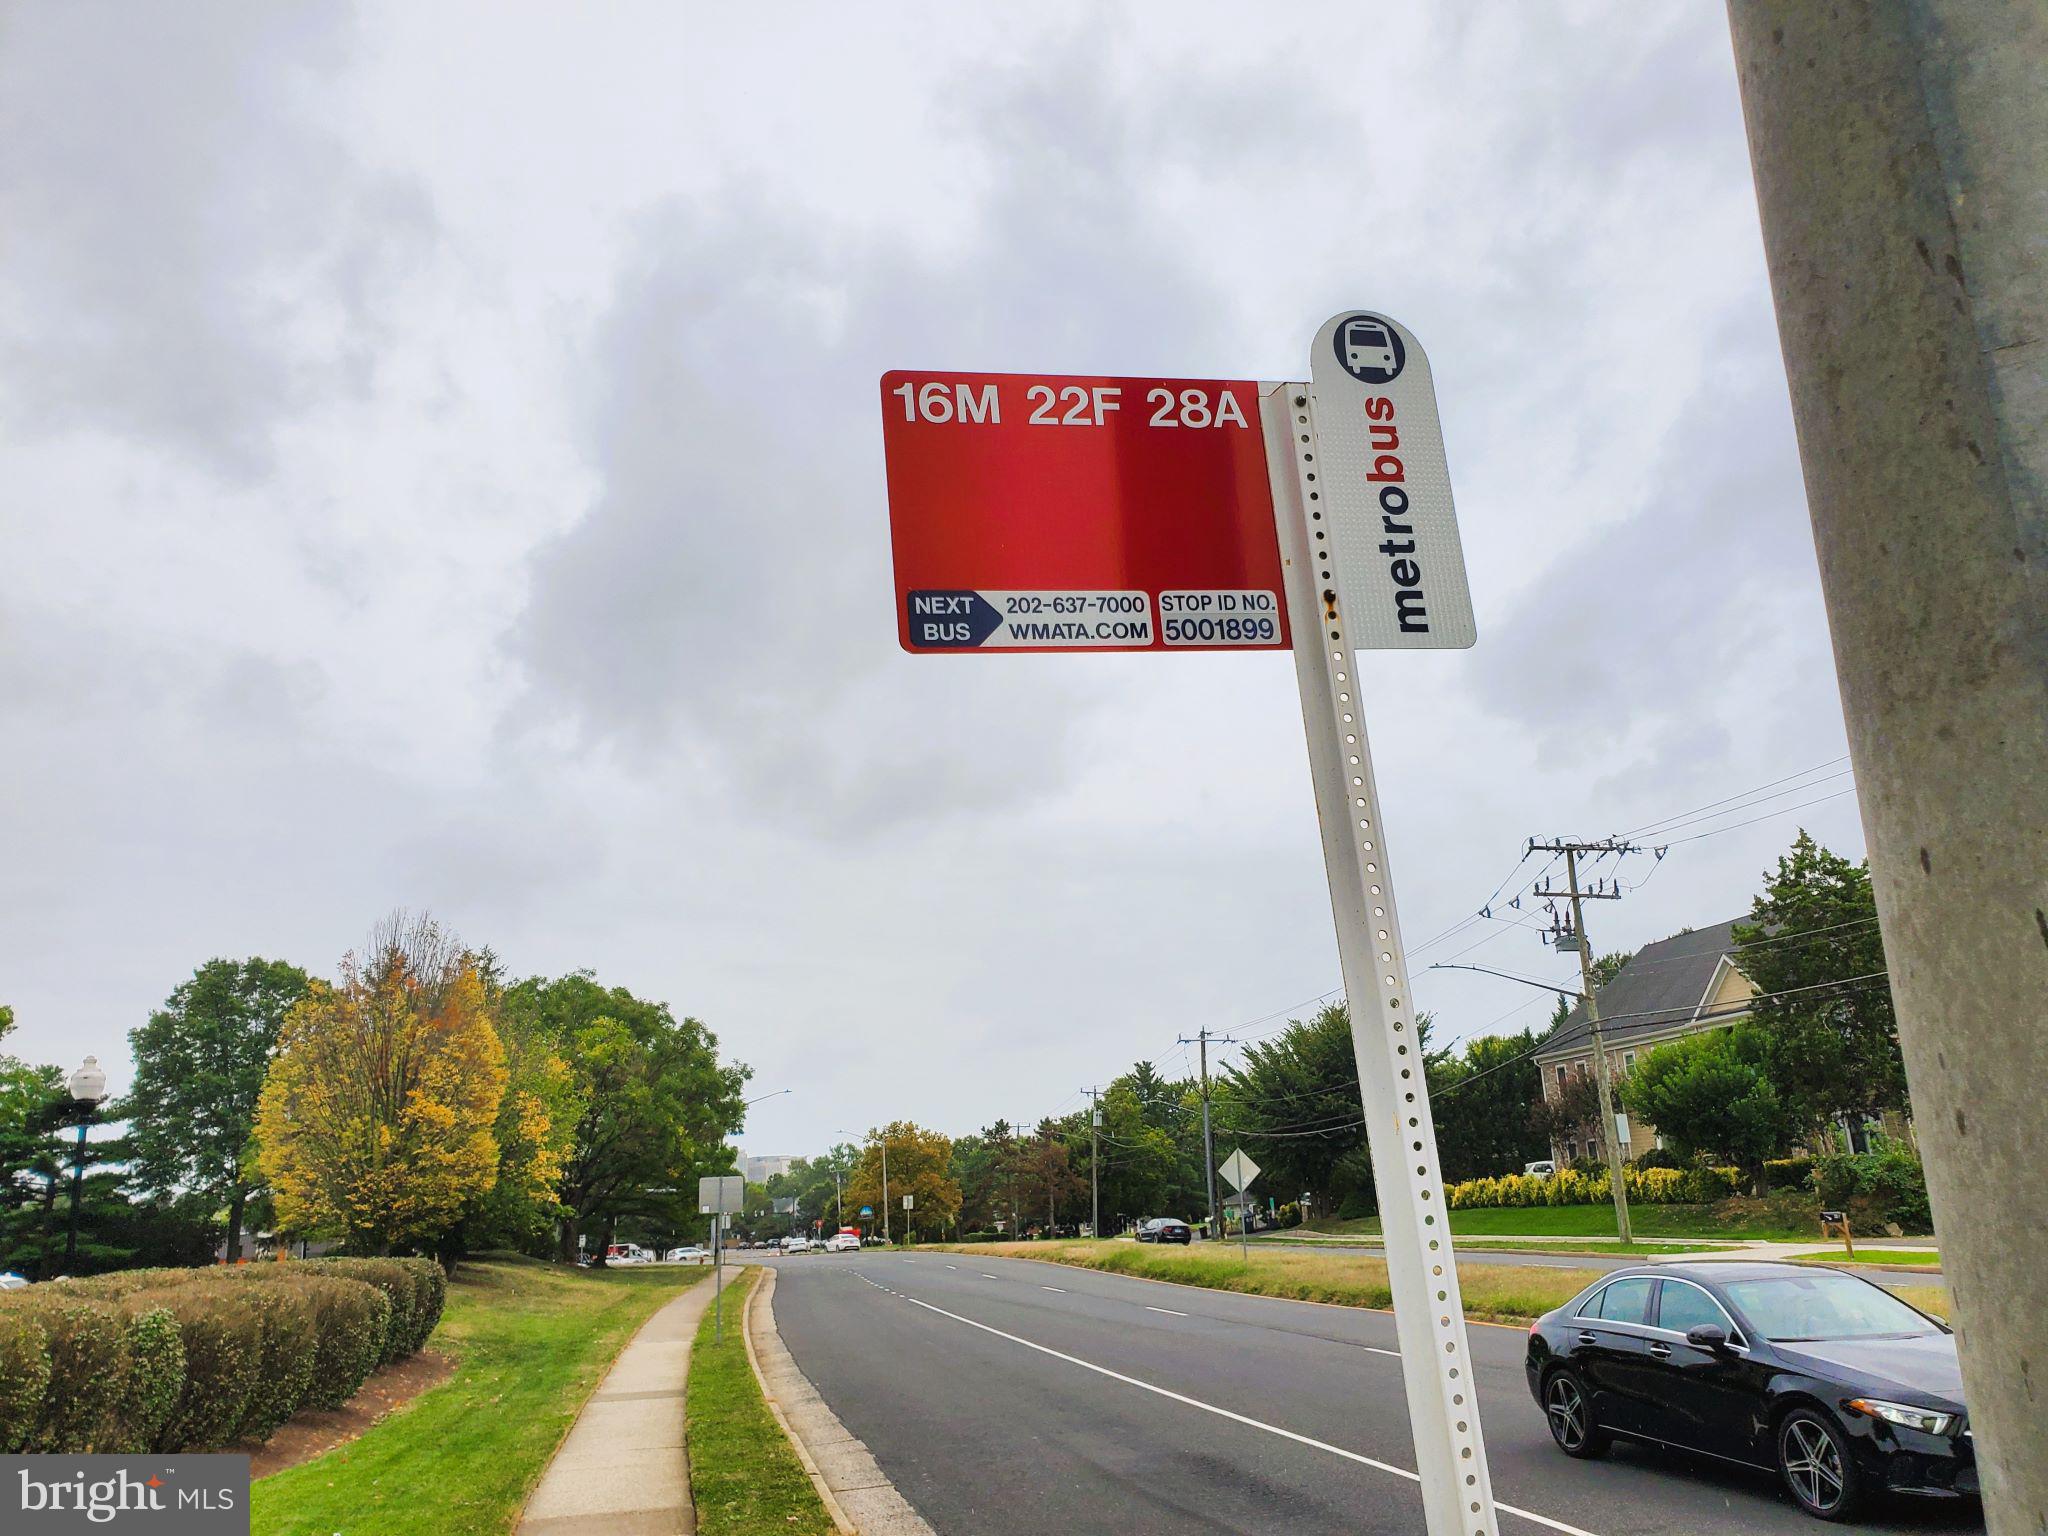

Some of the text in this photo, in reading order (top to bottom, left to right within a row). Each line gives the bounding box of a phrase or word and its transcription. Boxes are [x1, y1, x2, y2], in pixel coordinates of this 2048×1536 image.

[893, 382, 1249, 429] 16M 22F 28A
[1364, 396, 1430, 634] metrobus
[914, 597, 975, 615] NEXT
[1005, 597, 1145, 613] 202-637-7000
[1161, 593, 1277, 612] STOP ID NO.
[922, 623, 971, 642] BUS
[1008, 623, 1149, 640] WMATA.COM
[1165, 618, 1275, 641] 5001899
